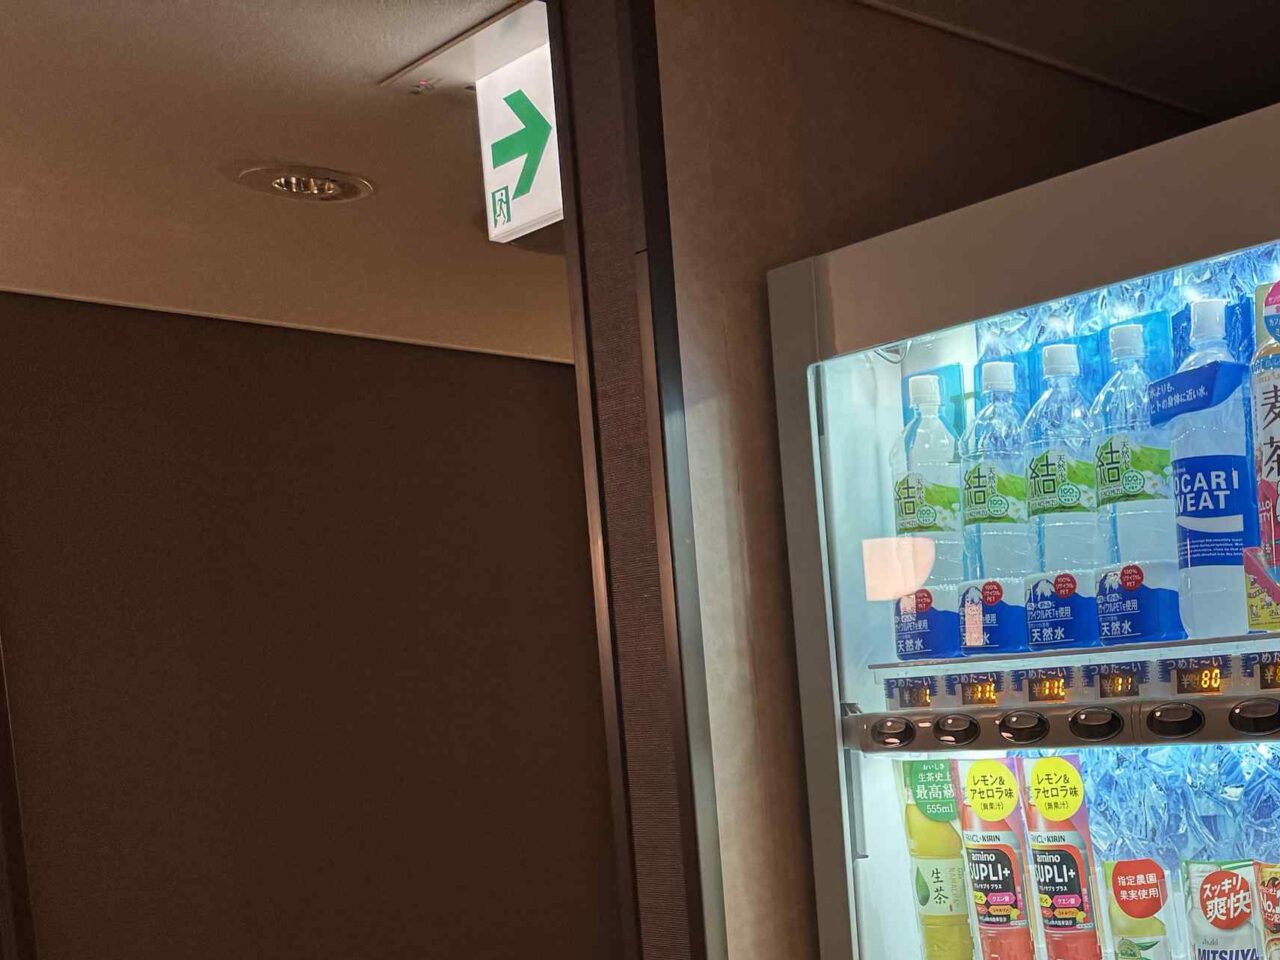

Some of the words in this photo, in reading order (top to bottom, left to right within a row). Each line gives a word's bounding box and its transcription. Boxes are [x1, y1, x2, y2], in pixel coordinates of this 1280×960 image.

[1096, 442, 1120, 485] 結
[1029, 455, 1056, 496] 結
[1174, 469, 1239, 497] OCARI
[964, 468, 986, 506] 結
[895, 479, 915, 515] 結
[1032, 626, 1064, 641] 天然水
[1102, 620, 1132, 636] 天然水
[897, 638, 924, 652] 天然水
[973, 775, 1005, 785] レモン&
[1037, 774, 1070, 784] レモン&
[970, 787, 1014, 800] アセロラ味
[1034, 787, 1079, 799] アセロラ味
[927, 803, 954, 814] 555ml
[1118, 873, 1157, 886] 指定農園
[1203, 876, 1242, 898] スッキリ
[1120, 888, 1159, 900] 果実使用
[1206, 892, 1251, 922] 爽快
